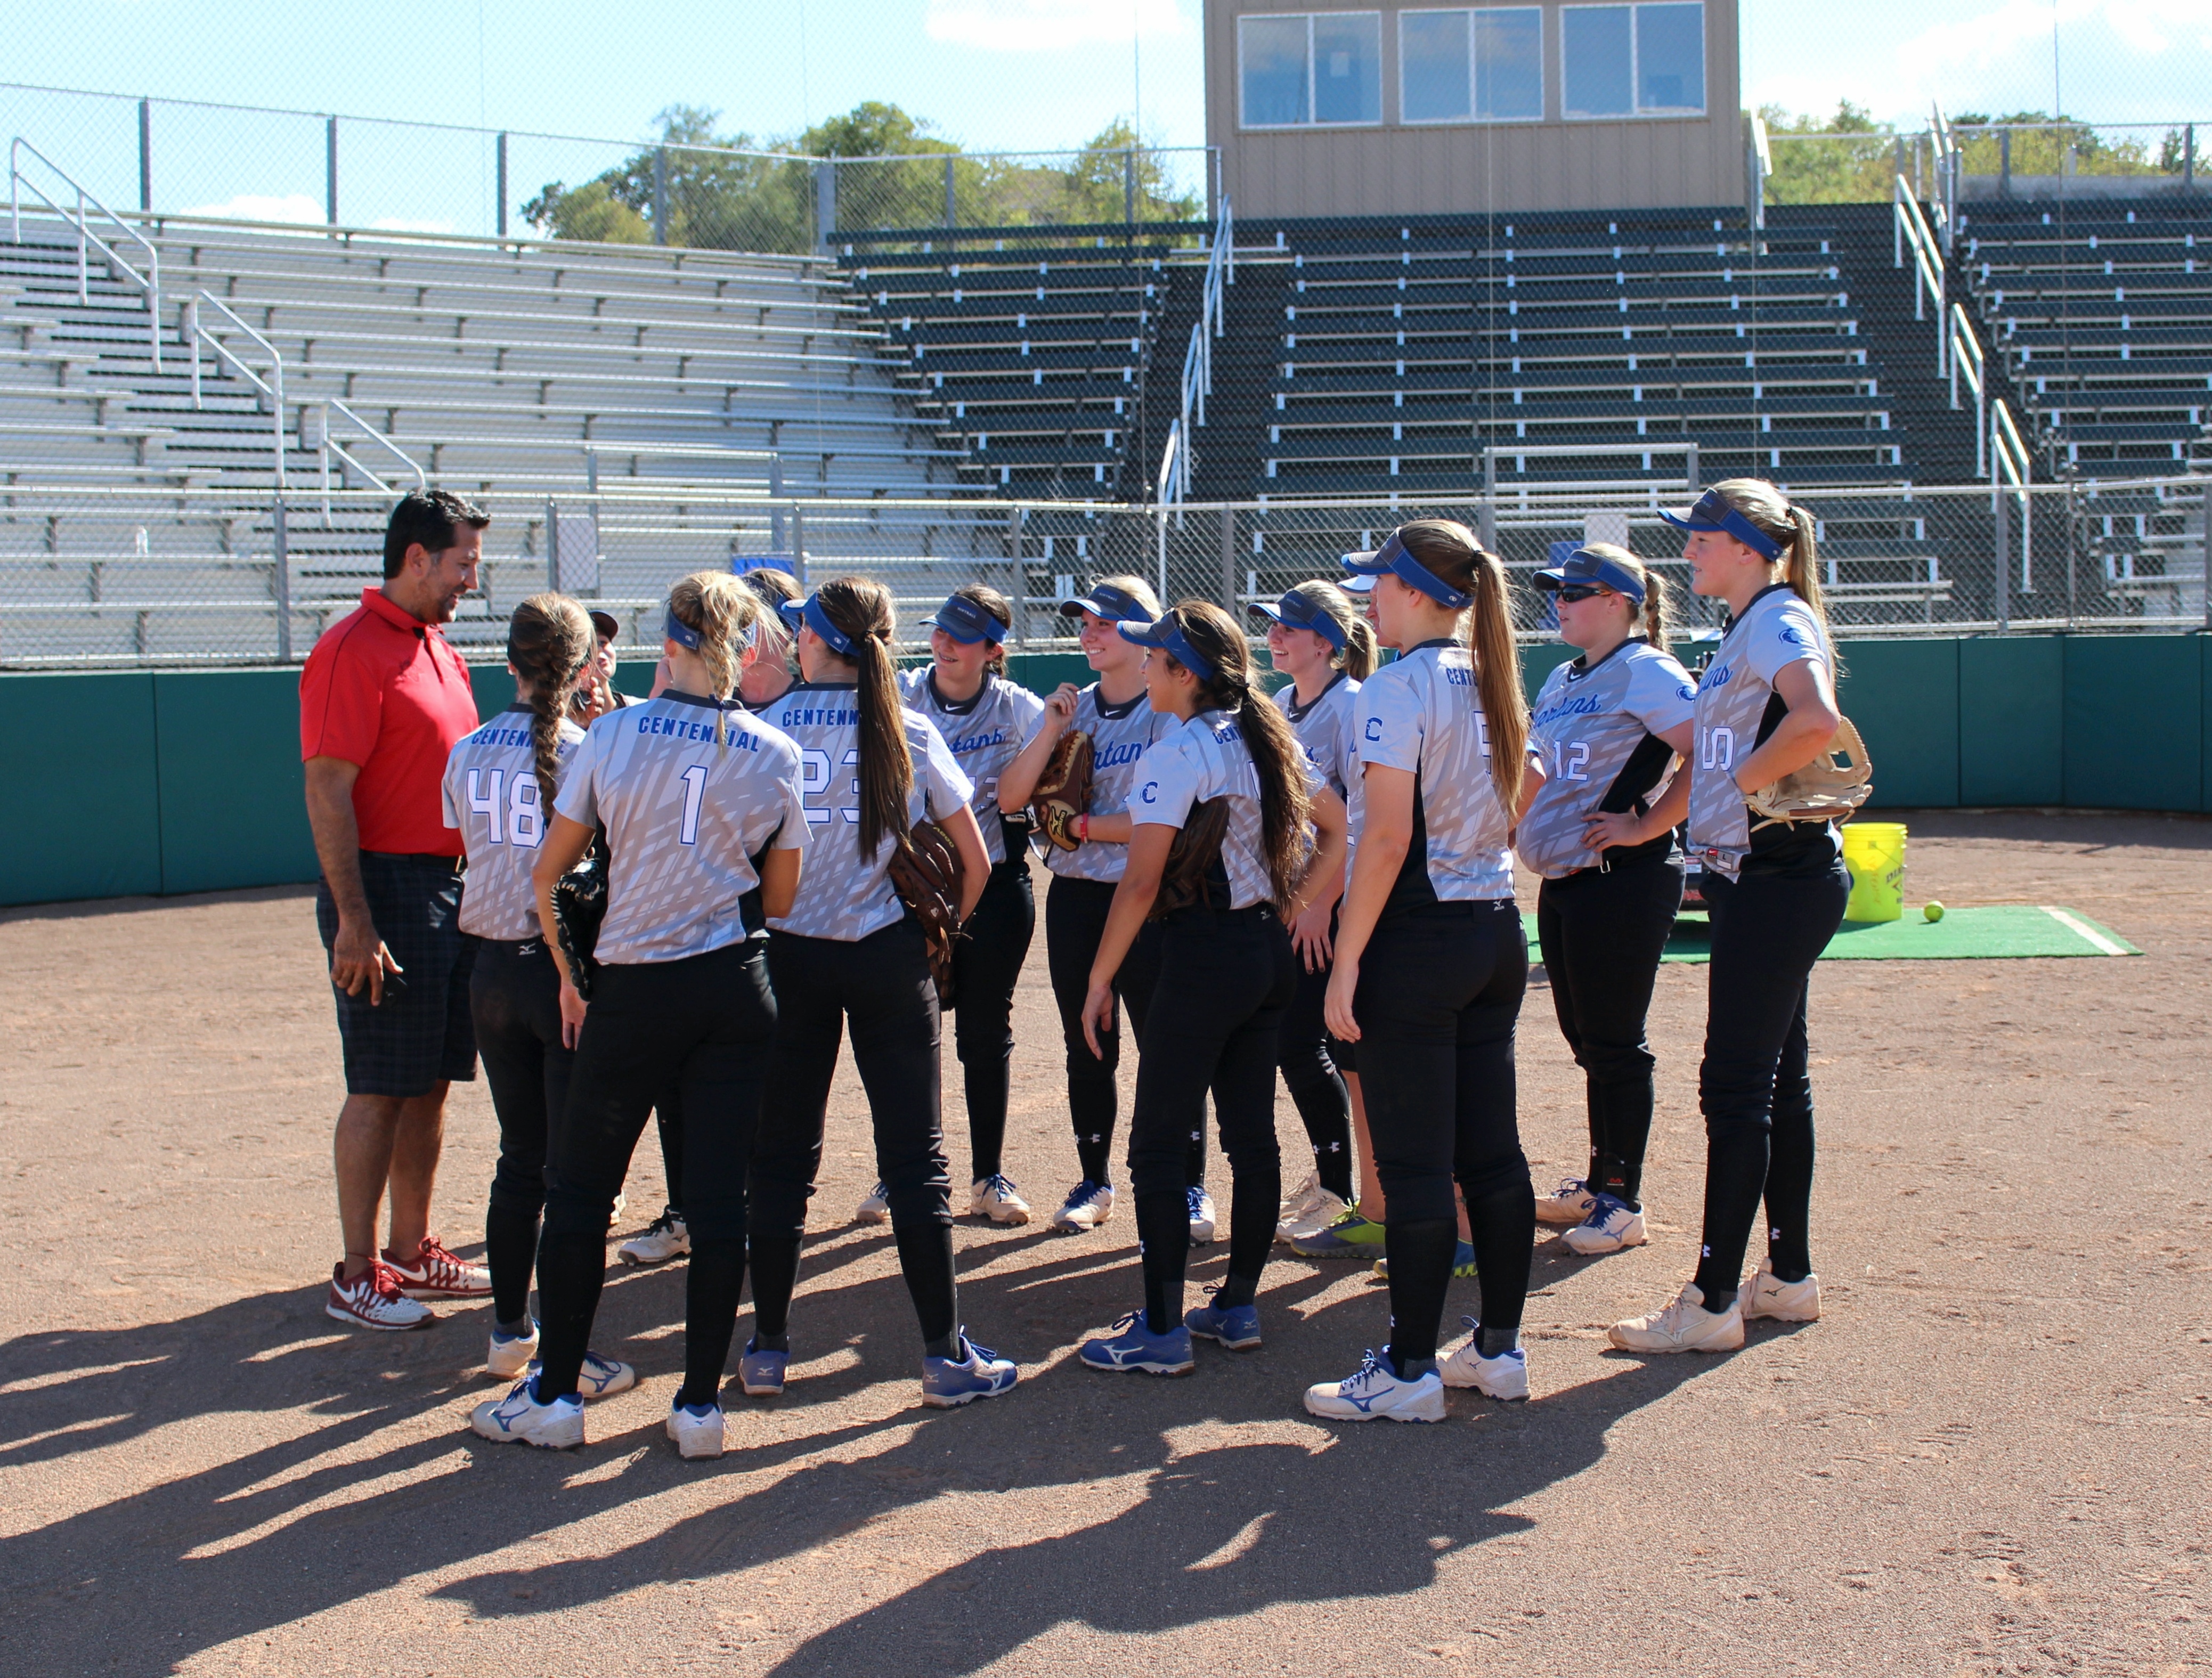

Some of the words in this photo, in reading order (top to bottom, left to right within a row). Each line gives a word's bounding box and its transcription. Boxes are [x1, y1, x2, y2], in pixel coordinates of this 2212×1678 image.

[783, 709, 859, 727] CENTENN
[803, 749, 860, 823] 23
[1553, 740, 1591, 781] 12
[467, 768, 546, 849] 48
[680, 765, 708, 845] 1
